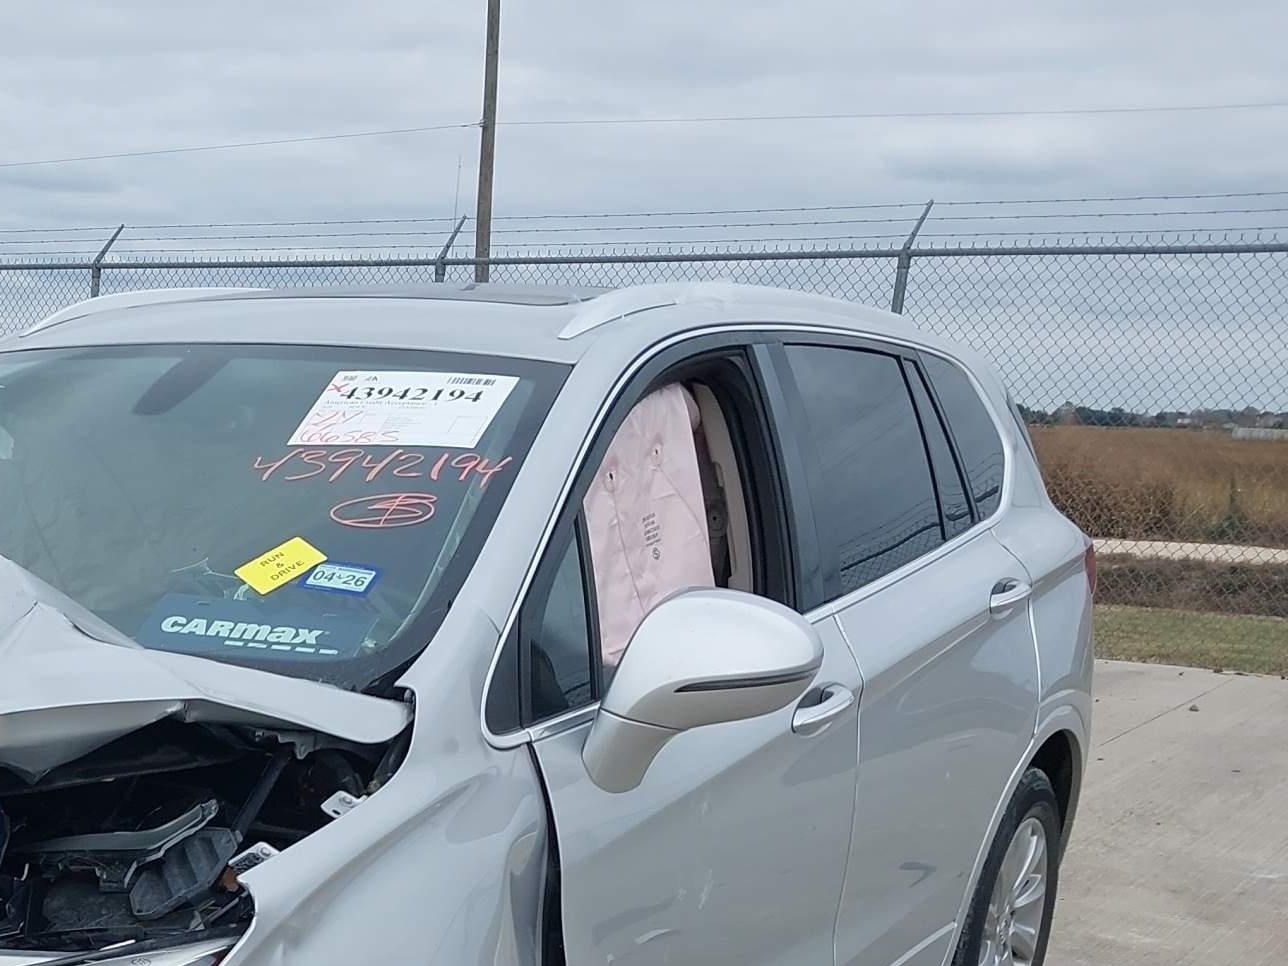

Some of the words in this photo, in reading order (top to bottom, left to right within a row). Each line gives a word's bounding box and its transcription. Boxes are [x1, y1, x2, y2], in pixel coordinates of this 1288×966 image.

[340, 386, 483, 403] 43942194
[253, 448, 512, 488] 43942194
[259, 551, 285, 567] RUN
[270, 559, 305, 581] DRIVE
[313, 570, 336, 582] 04
[342, 574, 367, 587] 26
